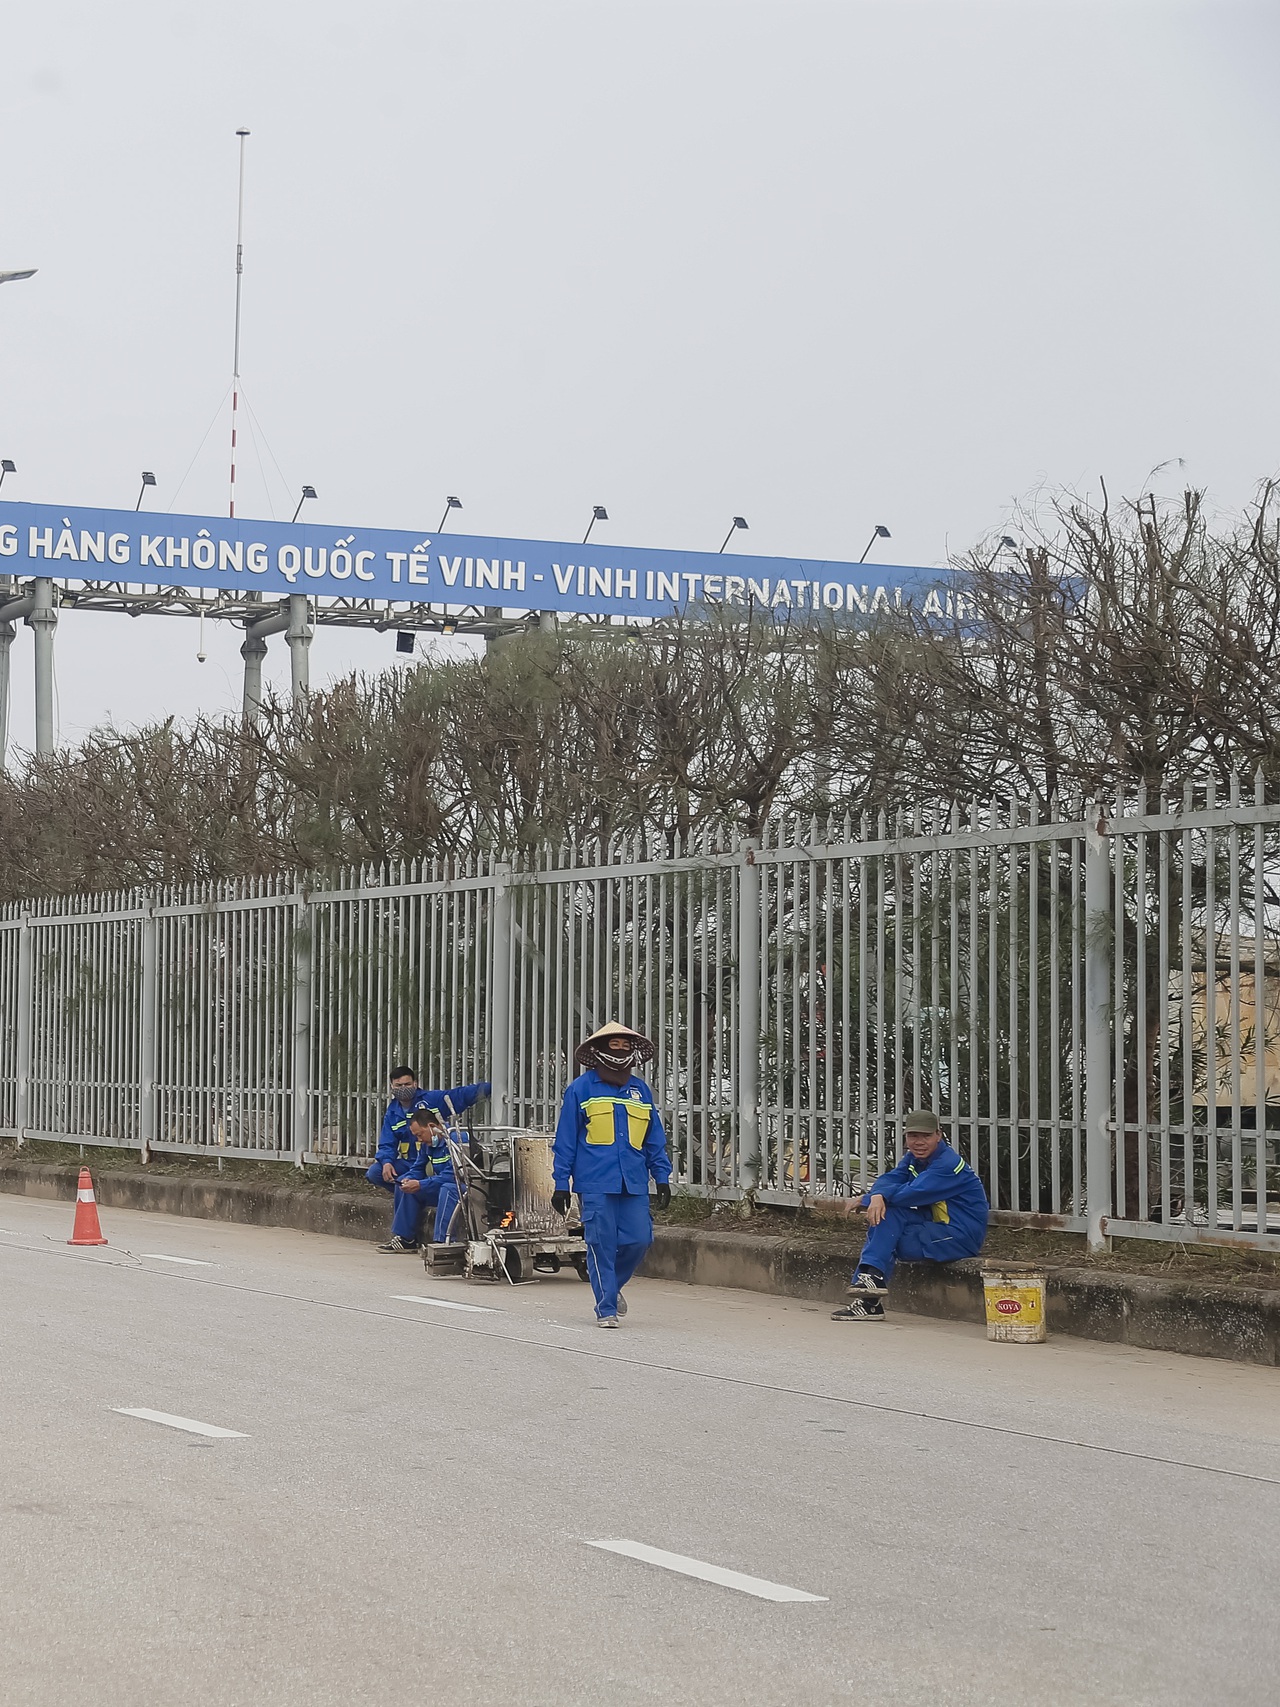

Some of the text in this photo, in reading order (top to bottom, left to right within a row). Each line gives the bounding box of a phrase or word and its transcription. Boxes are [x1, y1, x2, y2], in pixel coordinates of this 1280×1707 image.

[28, 517, 130, 564] HÀNG
[140, 528, 268, 574] KHÔNG
[277, 534, 376, 583] QUỐC
[386, 539, 432, 585] TẾ
[438, 555, 526, 591] VINH
[552, 563, 637, 599] VINH
[646, 570, 912, 617] INTERNATIONAL
[998, 1303, 1020, 1311] KOVA
